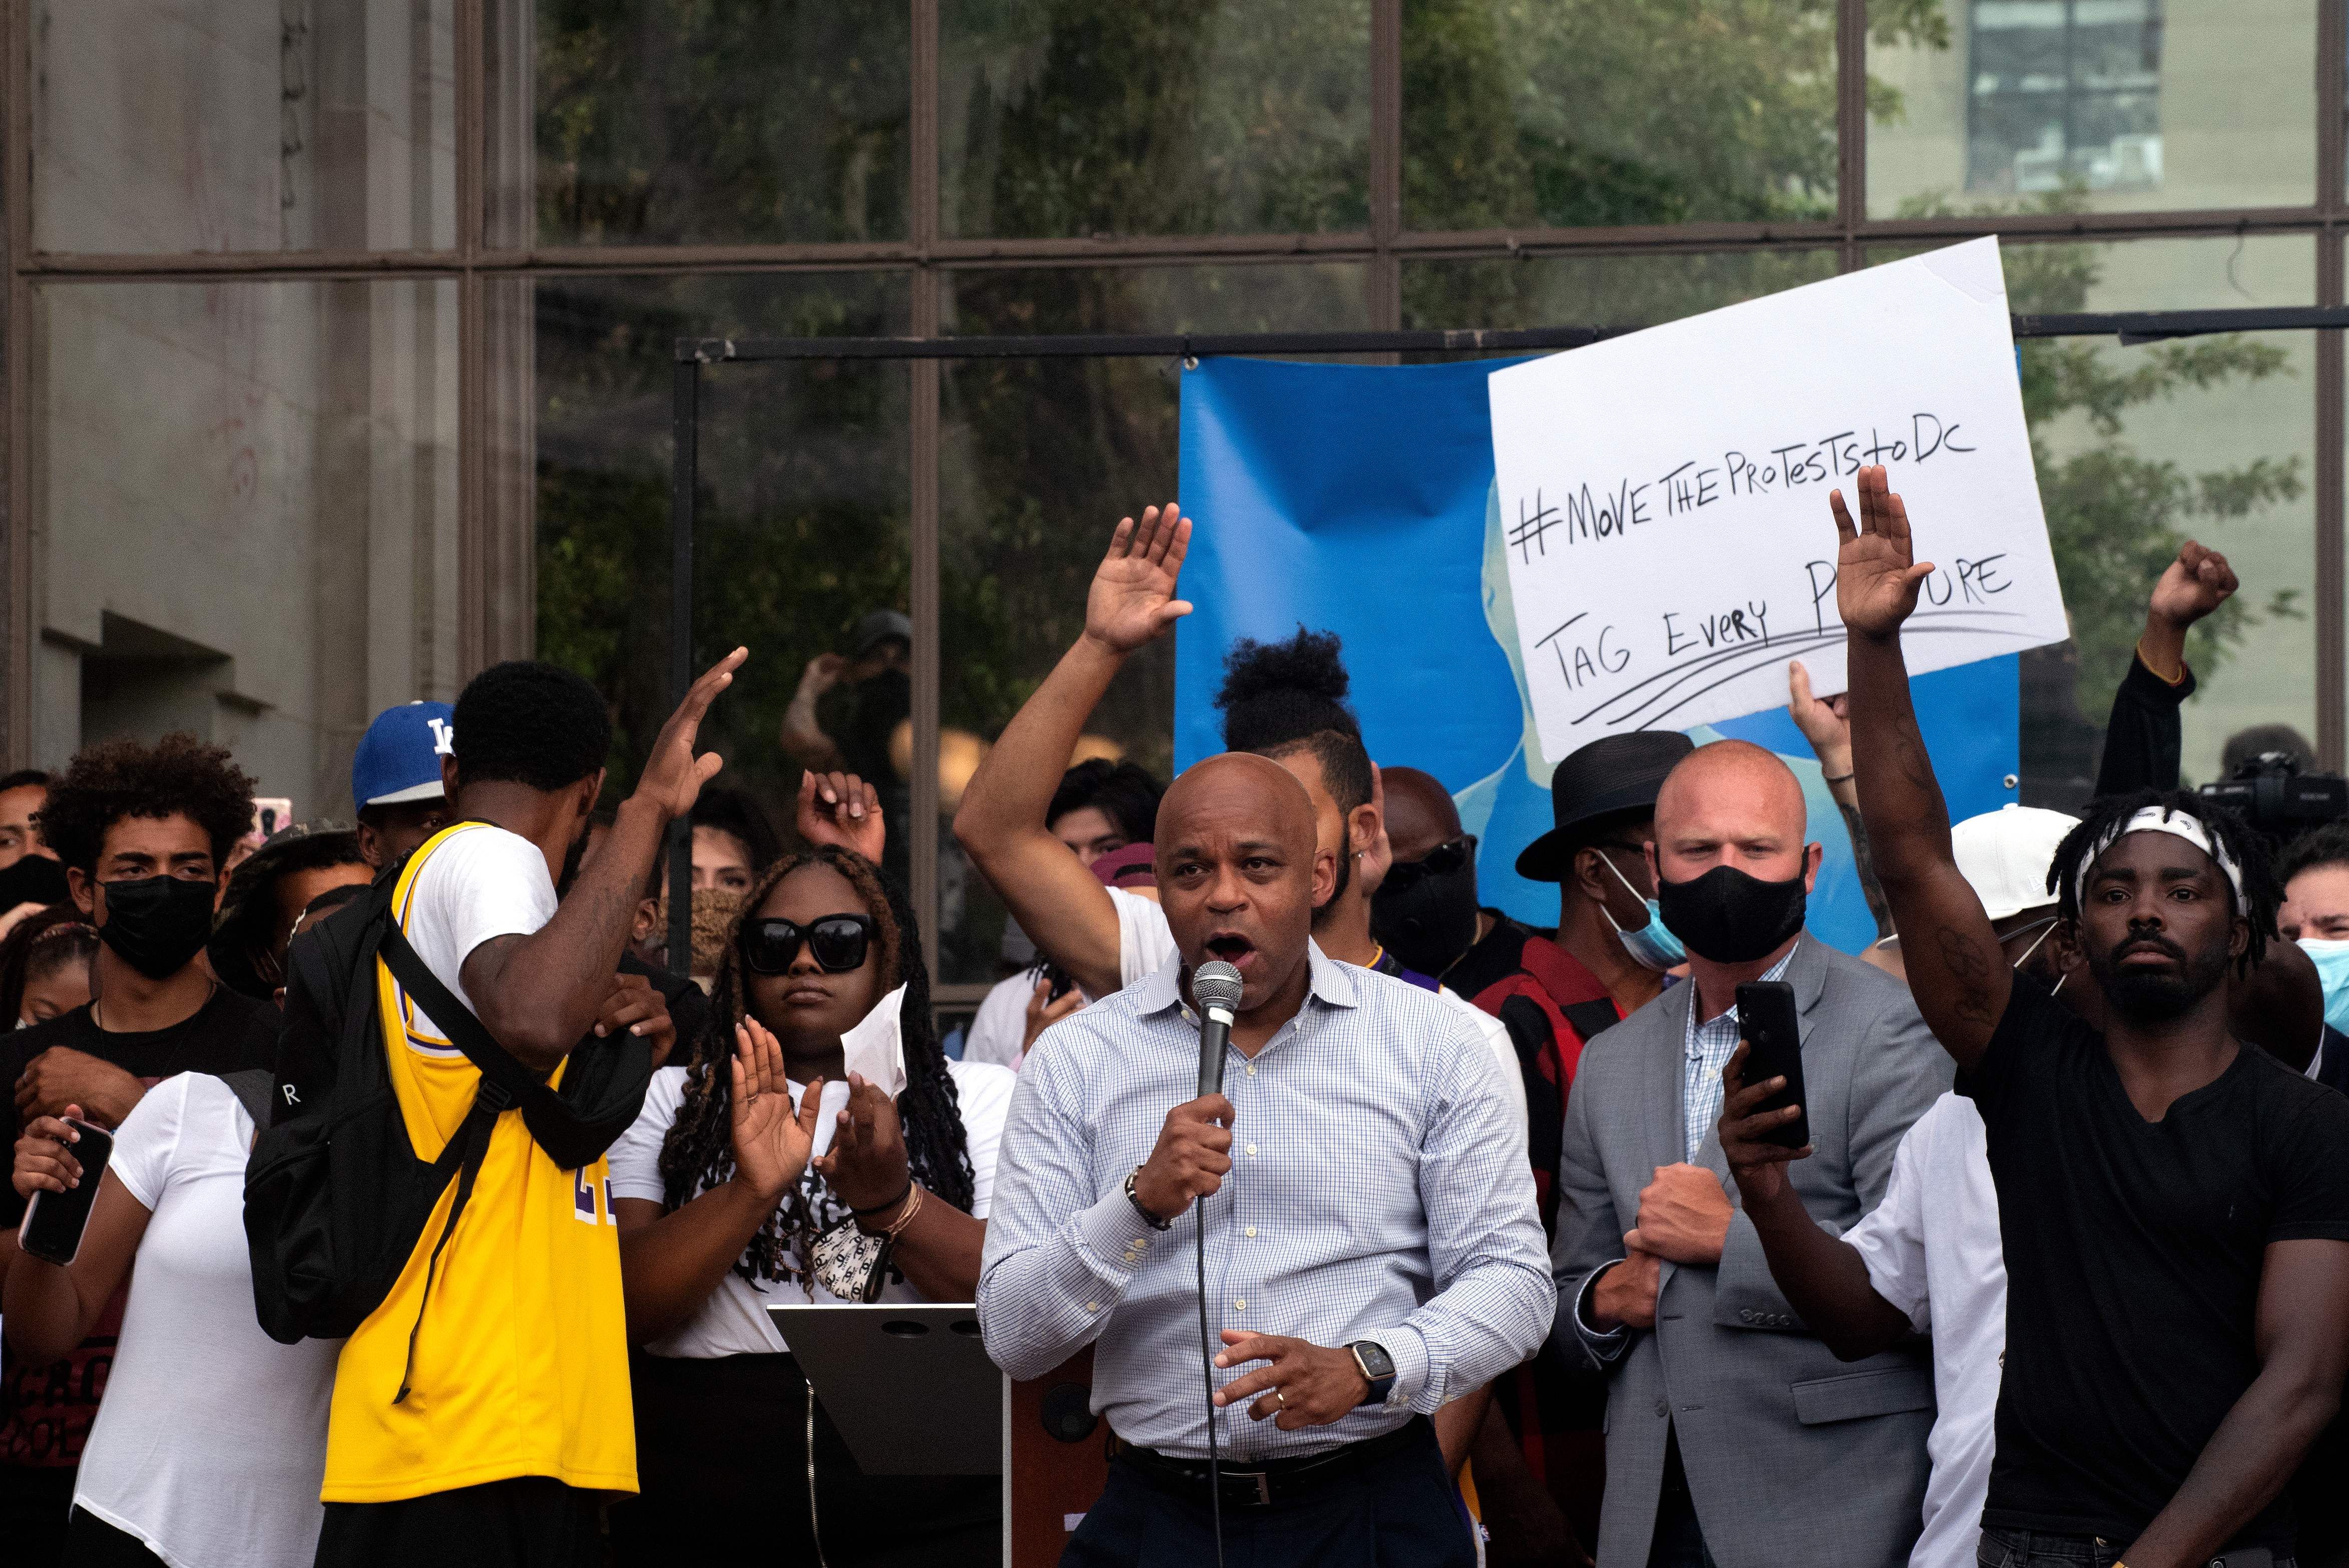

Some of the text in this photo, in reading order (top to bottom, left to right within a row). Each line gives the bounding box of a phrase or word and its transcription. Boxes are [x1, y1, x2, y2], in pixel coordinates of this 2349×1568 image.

[1535, 612, 1630, 691] TAG
[1806, 553, 2012, 636] PURE
[282, 1084, 301, 1105] R
[841, 1252, 851, 1271] CHANEL
